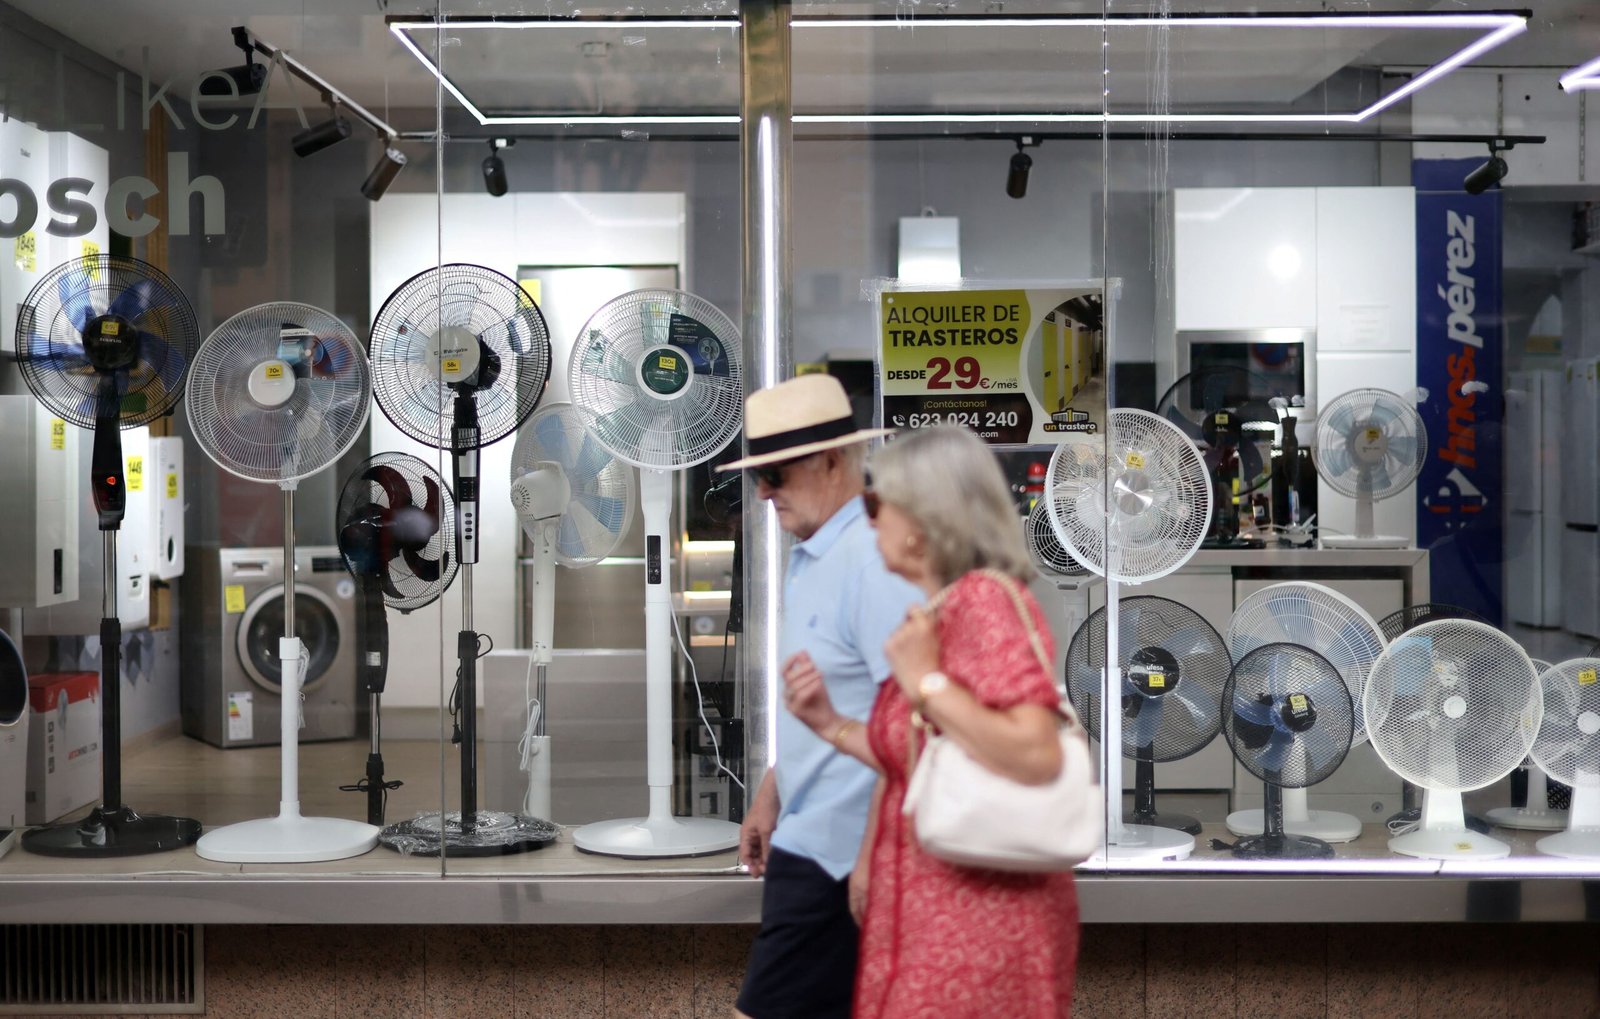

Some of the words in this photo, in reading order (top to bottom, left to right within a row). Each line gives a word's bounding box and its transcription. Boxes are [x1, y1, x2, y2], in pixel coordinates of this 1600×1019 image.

[1438, 210, 1484, 348] pérez
[887, 305, 986, 325] ALQUILER
[994, 304, 1020, 322] DE
[888, 328, 1018, 347] TRASTEROS
[887, 369, 926, 380] DESDE
[923, 399, 987, 410] ¡Contáctanos!
[909, 413, 941, 429] 623
[947, 412, 979, 428] 024
[986, 411, 1018, 427] 240
[1058, 422, 1096, 431] trastero
[1146, 663, 1164, 671] ufesa
